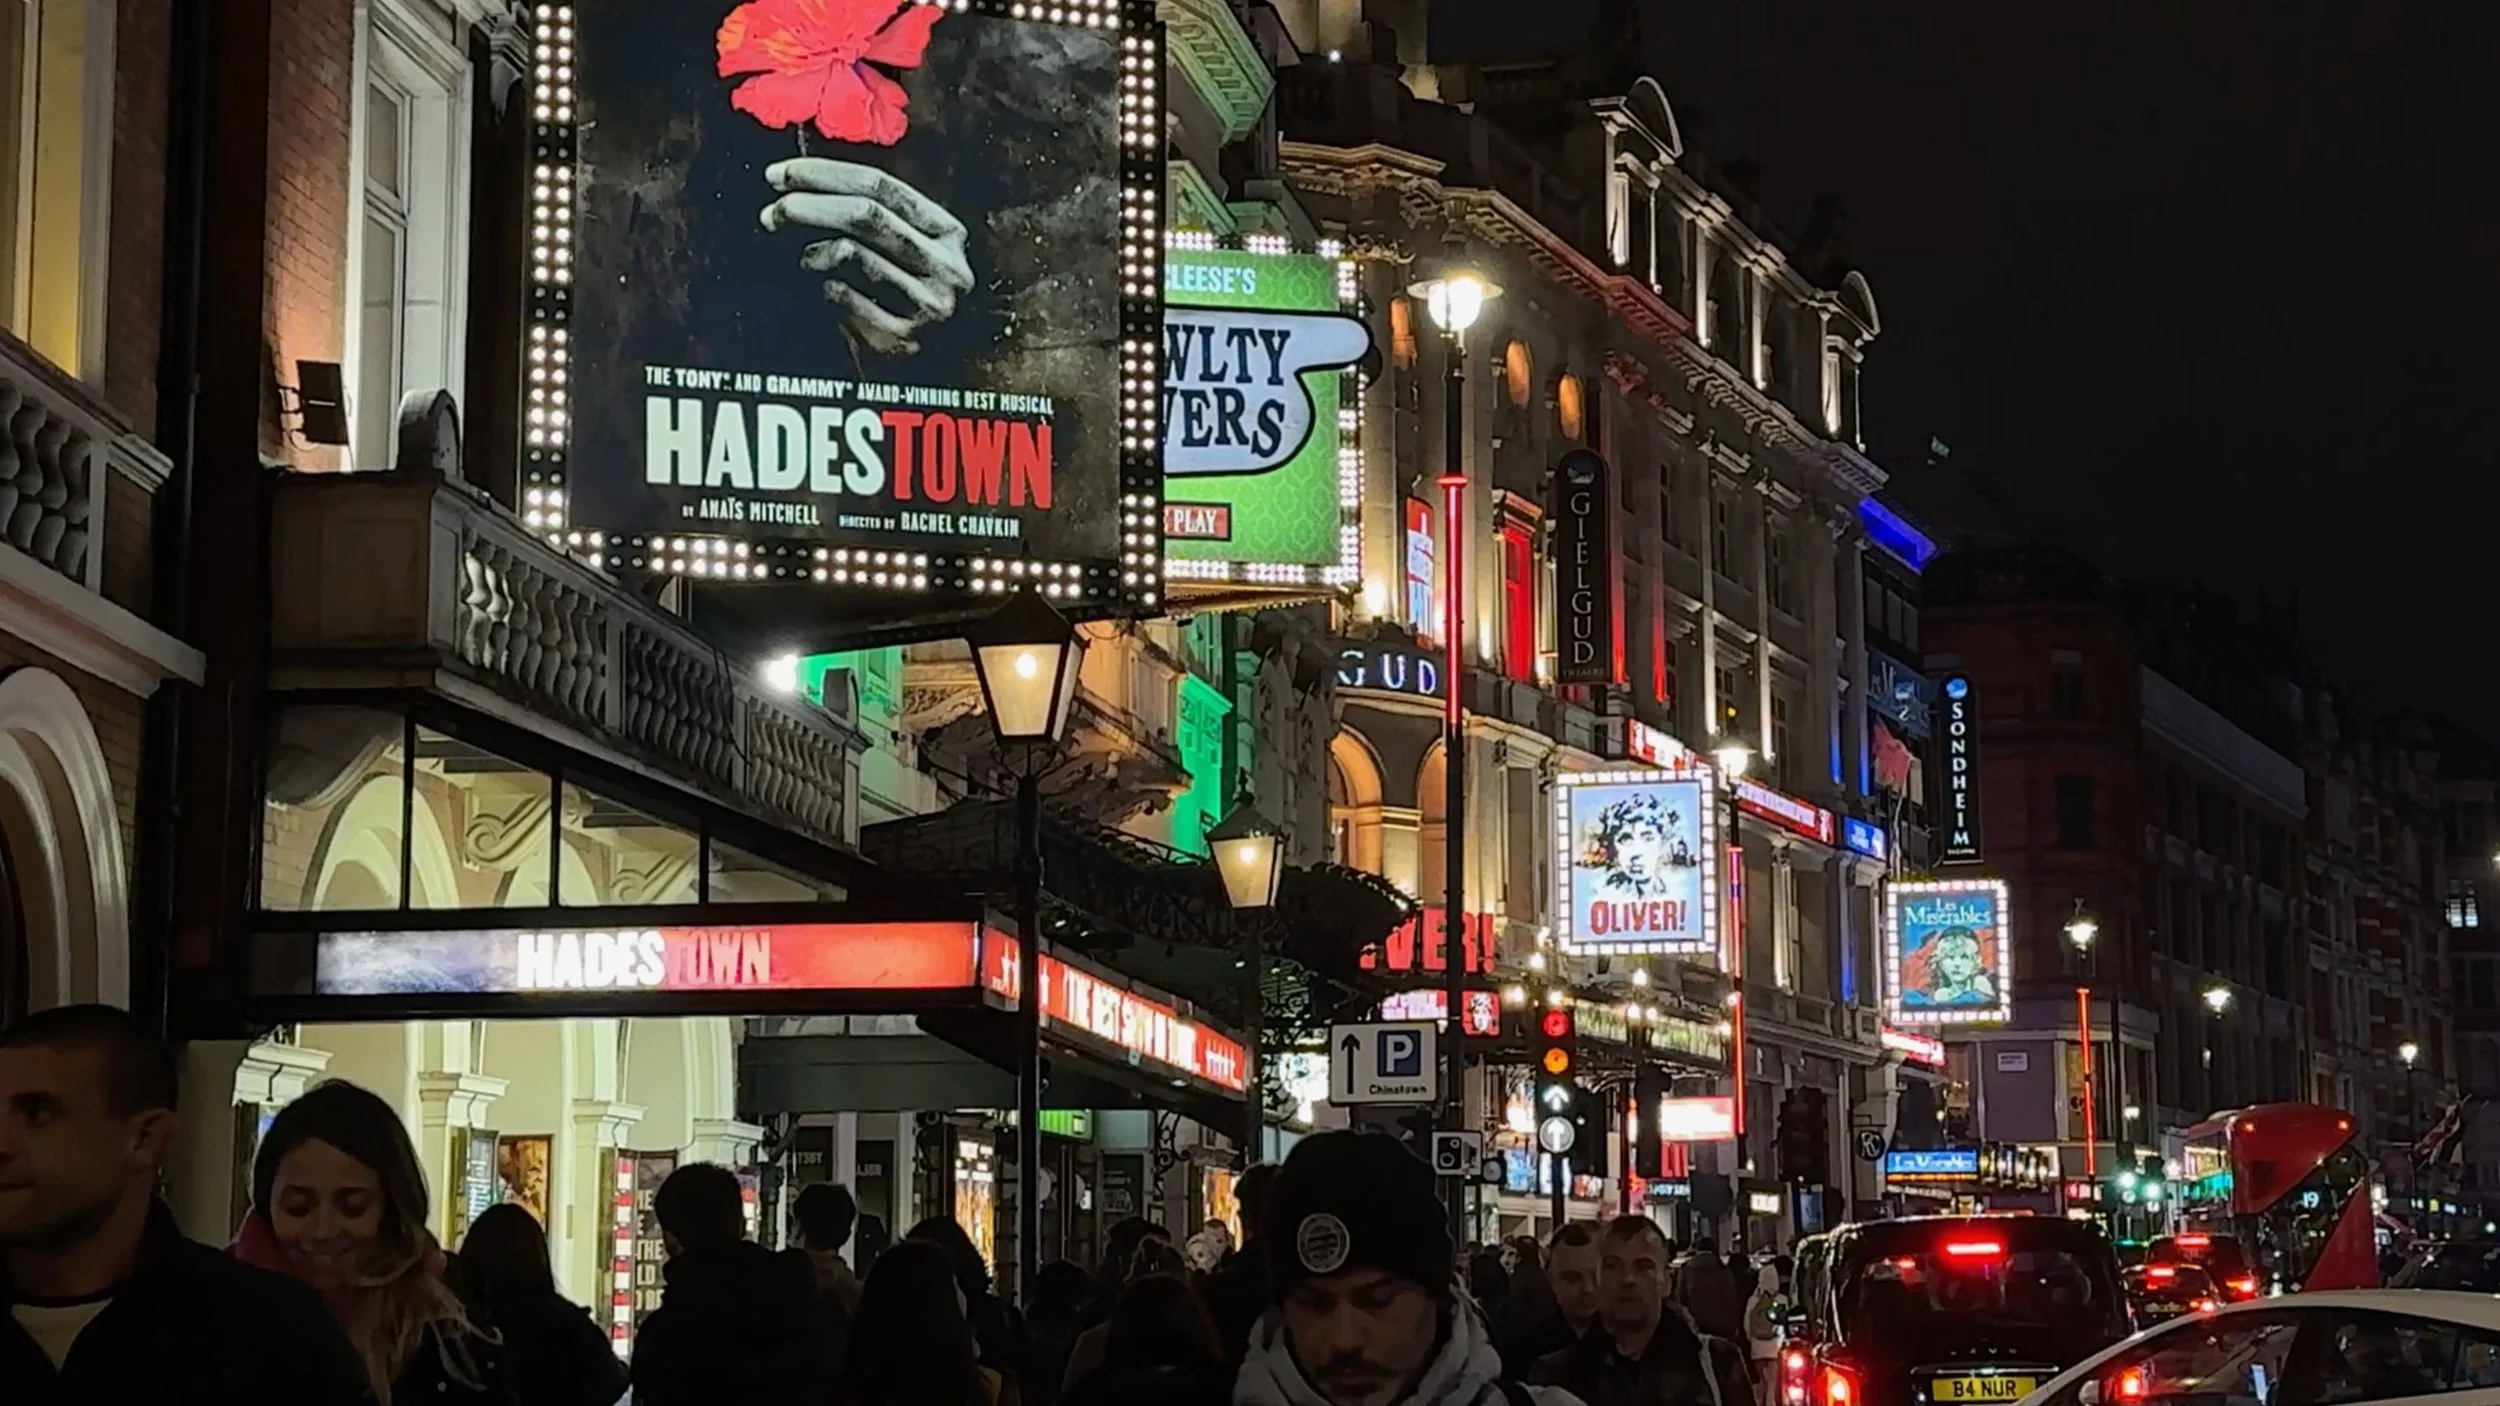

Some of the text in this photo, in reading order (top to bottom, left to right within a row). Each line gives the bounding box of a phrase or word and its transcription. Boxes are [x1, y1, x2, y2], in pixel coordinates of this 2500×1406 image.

[645, 366, 671, 386] THE
[735, 373, 761, 392] AND
[857, 382, 960, 408] AWARD-WINNING
[964, 391, 995, 411] BEST
[1000, 393, 1054, 415] MUSICAL
[646, 396, 1053, 510] HADESTOWN
[699, 496, 744, 520] ANAÏS
[749, 502, 820, 525] MITCHELL
[900, 510, 955, 534] RACHEL
[959, 515, 1020, 538] CHAVKIN
[1172, 507, 1216, 535] PLAY
[1570, 491, 1595, 665] GIELGUD
[1949, 701, 1970, 846] SONDHEIM
[1590, 899, 1687, 935] OLIVER!
[517, 930, 771, 989] HADESTOWN
[1385, 1034, 1414, 1073] P
[1368, 1084, 1428, 1096] Chinatown
[2303, 1191, 2320, 1209] 19
[1953, 1380, 2017, 1398] B4 NUR
